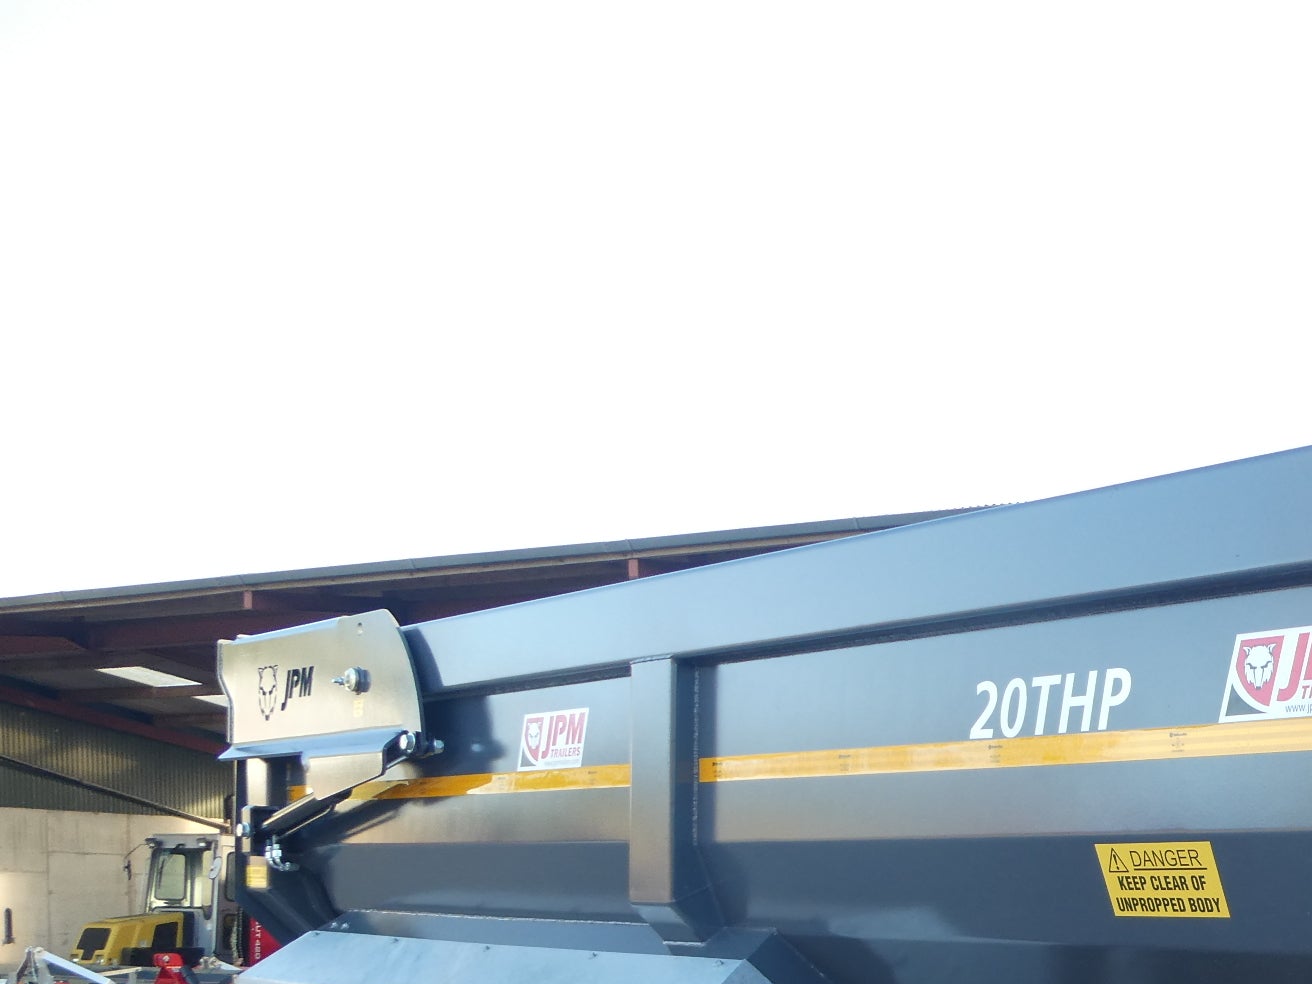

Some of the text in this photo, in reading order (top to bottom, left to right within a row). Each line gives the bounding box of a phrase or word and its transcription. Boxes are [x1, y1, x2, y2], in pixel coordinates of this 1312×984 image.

[281, 665, 314, 711] JPM
[969, 667, 1132, 740] 20THP
[541, 711, 586, 760] JPM
[551, 746, 581, 758] TRAILERS
[1129, 849, 1202, 867] DANGER
[1117, 875, 1207, 891] KEEP CLEAR OF
[1116, 897, 1221, 913] UNPROPPED BODY
